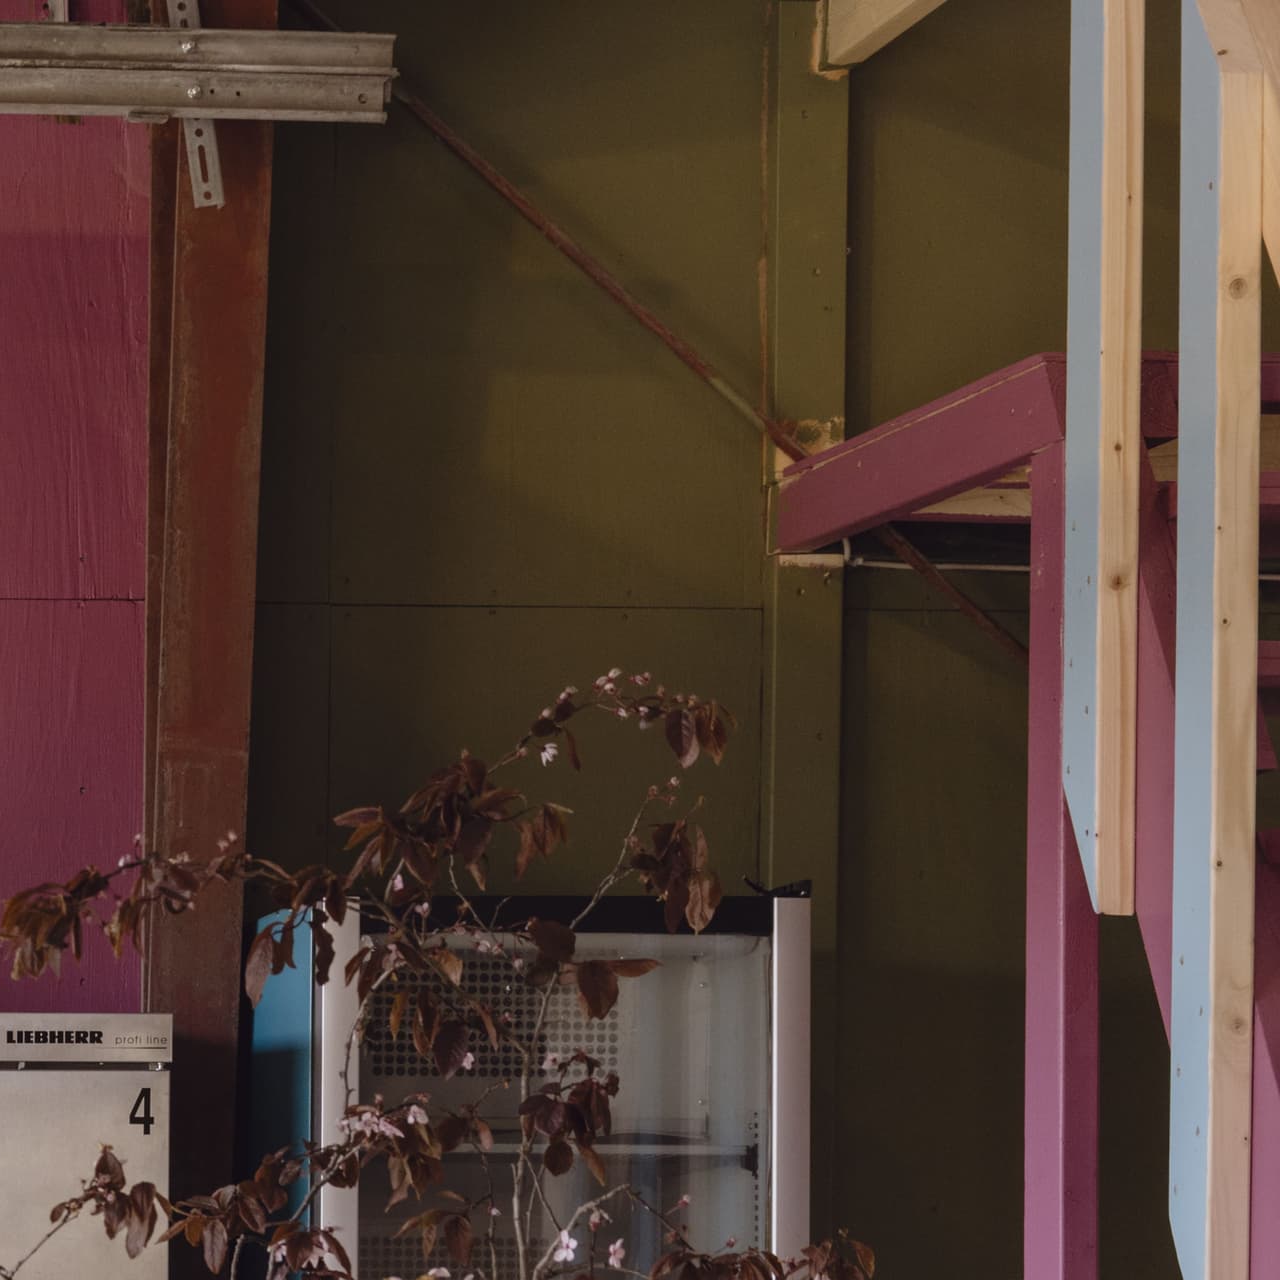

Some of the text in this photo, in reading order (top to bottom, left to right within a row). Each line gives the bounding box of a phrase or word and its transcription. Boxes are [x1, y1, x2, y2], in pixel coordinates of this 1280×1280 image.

[6, 1030, 168, 1045] LIEBHERR profi line
[129, 1087, 154, 1135] 4
